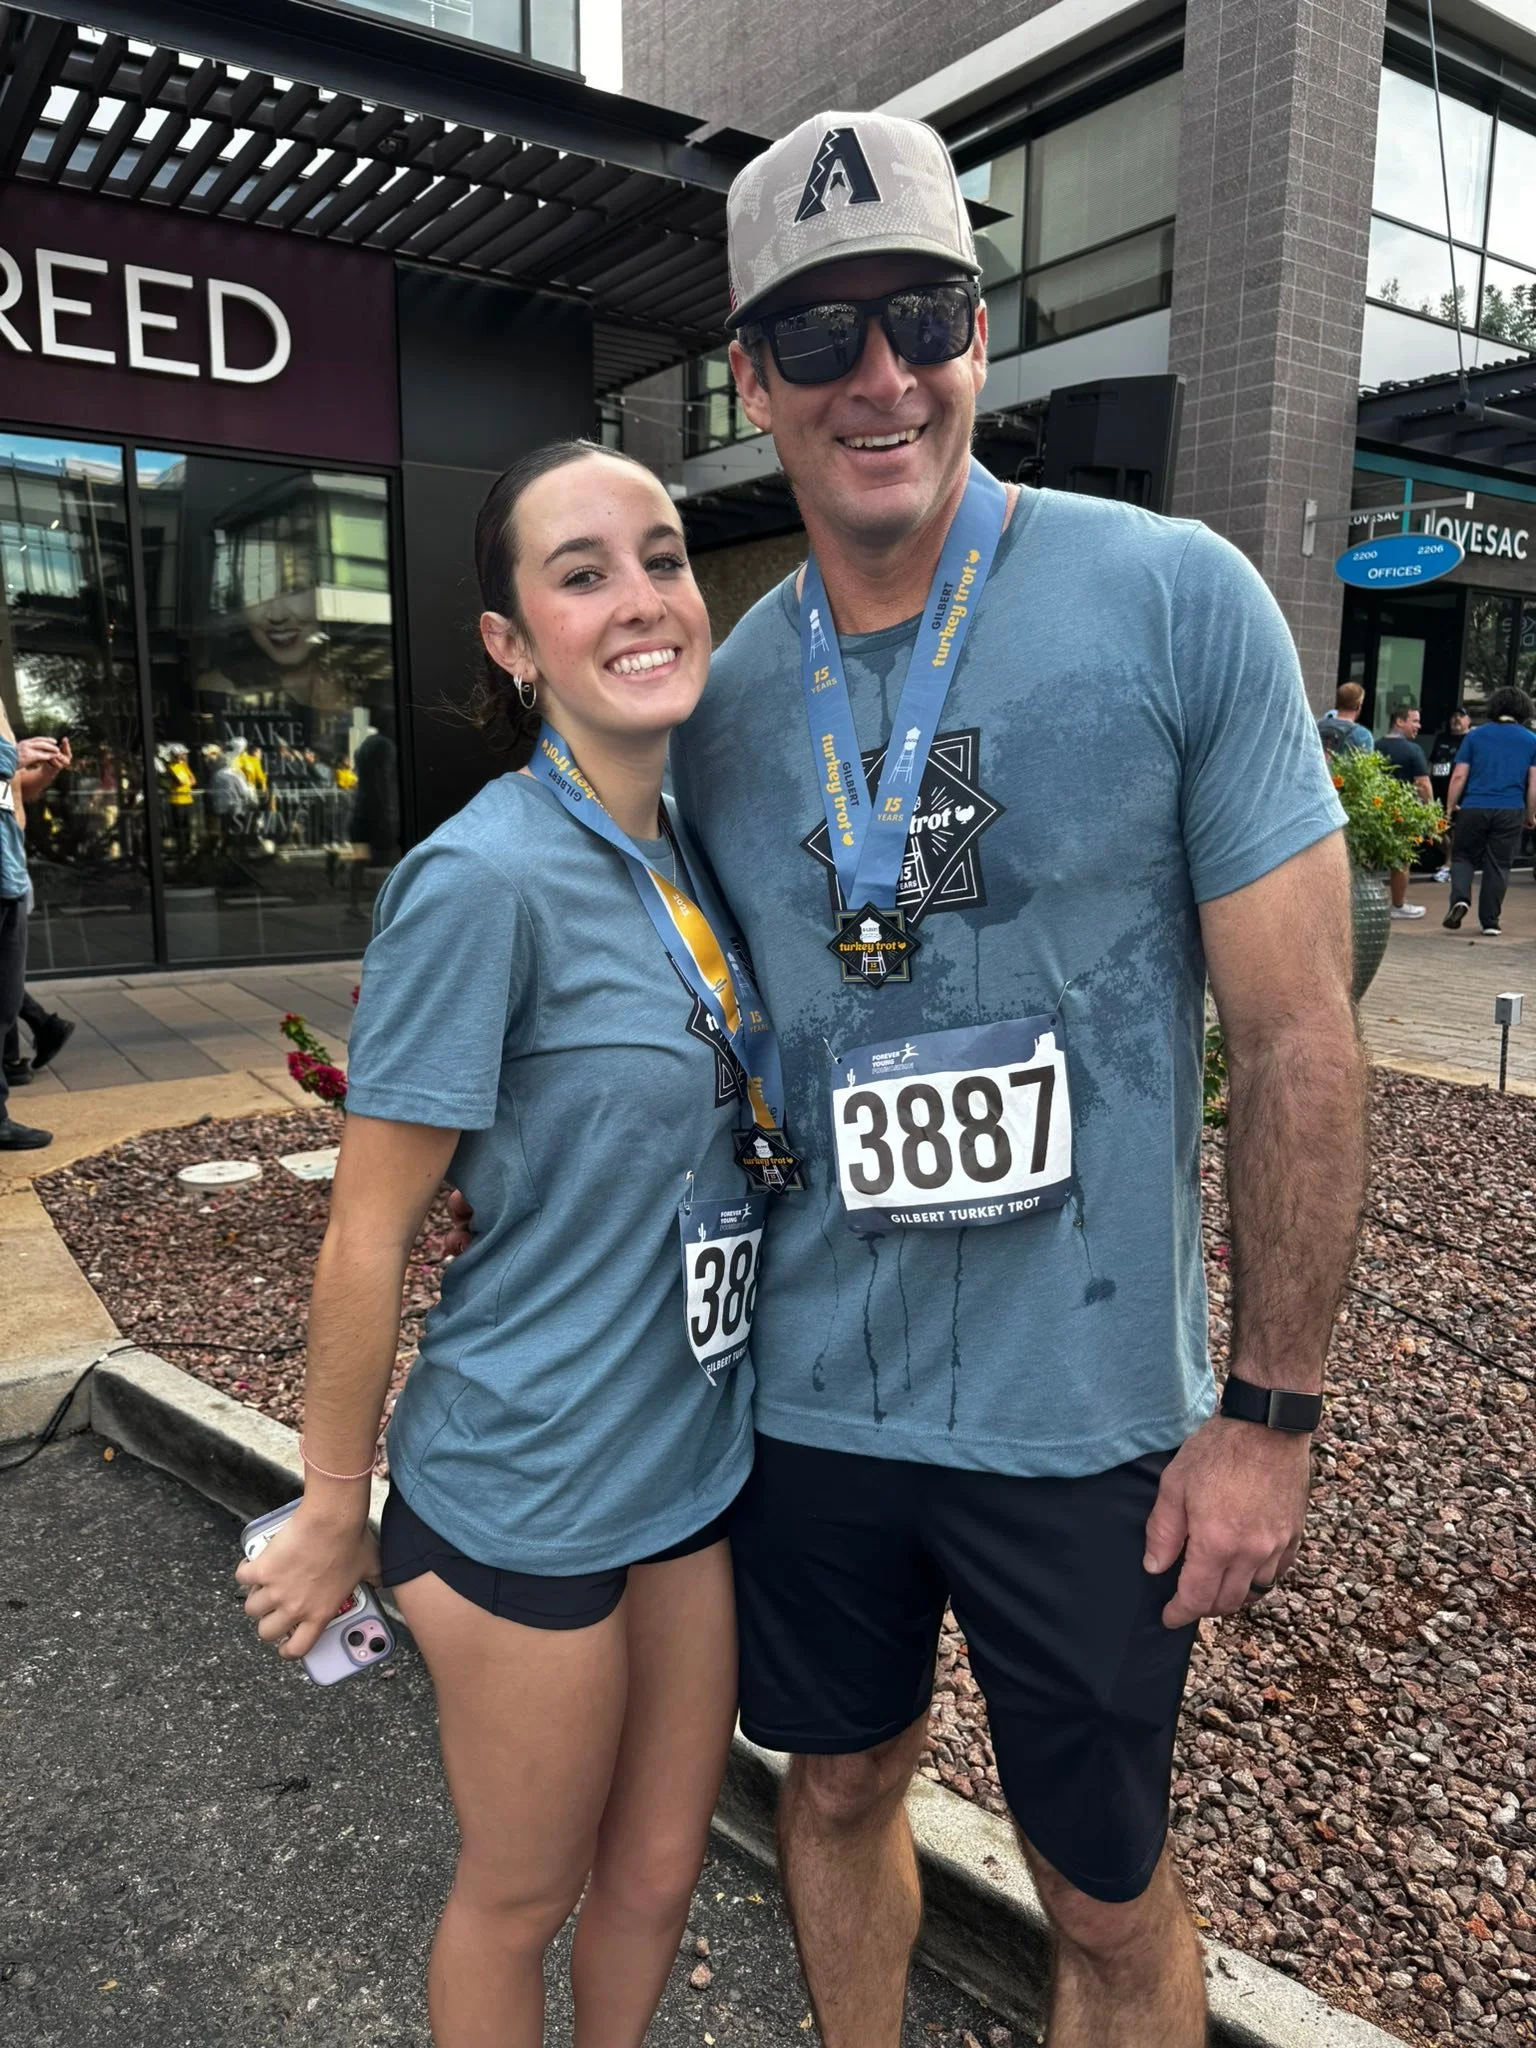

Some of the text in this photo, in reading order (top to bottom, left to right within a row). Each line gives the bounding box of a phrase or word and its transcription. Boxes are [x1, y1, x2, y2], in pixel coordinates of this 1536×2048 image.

[794, 127, 883, 226] A
[1353, 544, 1444, 561] 2200 2206
[1368, 565, 1422, 579] OFFICES
[932, 582, 954, 630] GILBERT
[932, 566, 977, 668] turkey trot
[813, 666, 830, 684] 15
[811, 677, 837, 694] YEARS
[223, 721, 305, 747] MAKE
[548, 768, 583, 802] GILBERT
[821, 733, 852, 830] turkey trot
[842, 762, 860, 807] GILBERT
[884, 797, 902, 812] 15
[877, 813, 904, 823] YEARS
[909, 807, 952, 835] trot
[897, 880, 917, 890] EARS
[673, 893, 691, 917] 2025
[839, 941, 897, 953] turkey trot
[750, 1011, 762, 1023] 15
[872, 1051, 900, 1061] FOREVER
[872, 1058, 895, 1068] YOUNG
[843, 1065, 1056, 1195] 3887
[720, 1210, 742, 1218] FOREVER
[890, 1196, 1041, 1224] GILBERT TURKEY TROT
[720, 1216, 738, 1225] YOUNG
[706, 1354, 732, 1375] GILBERT
